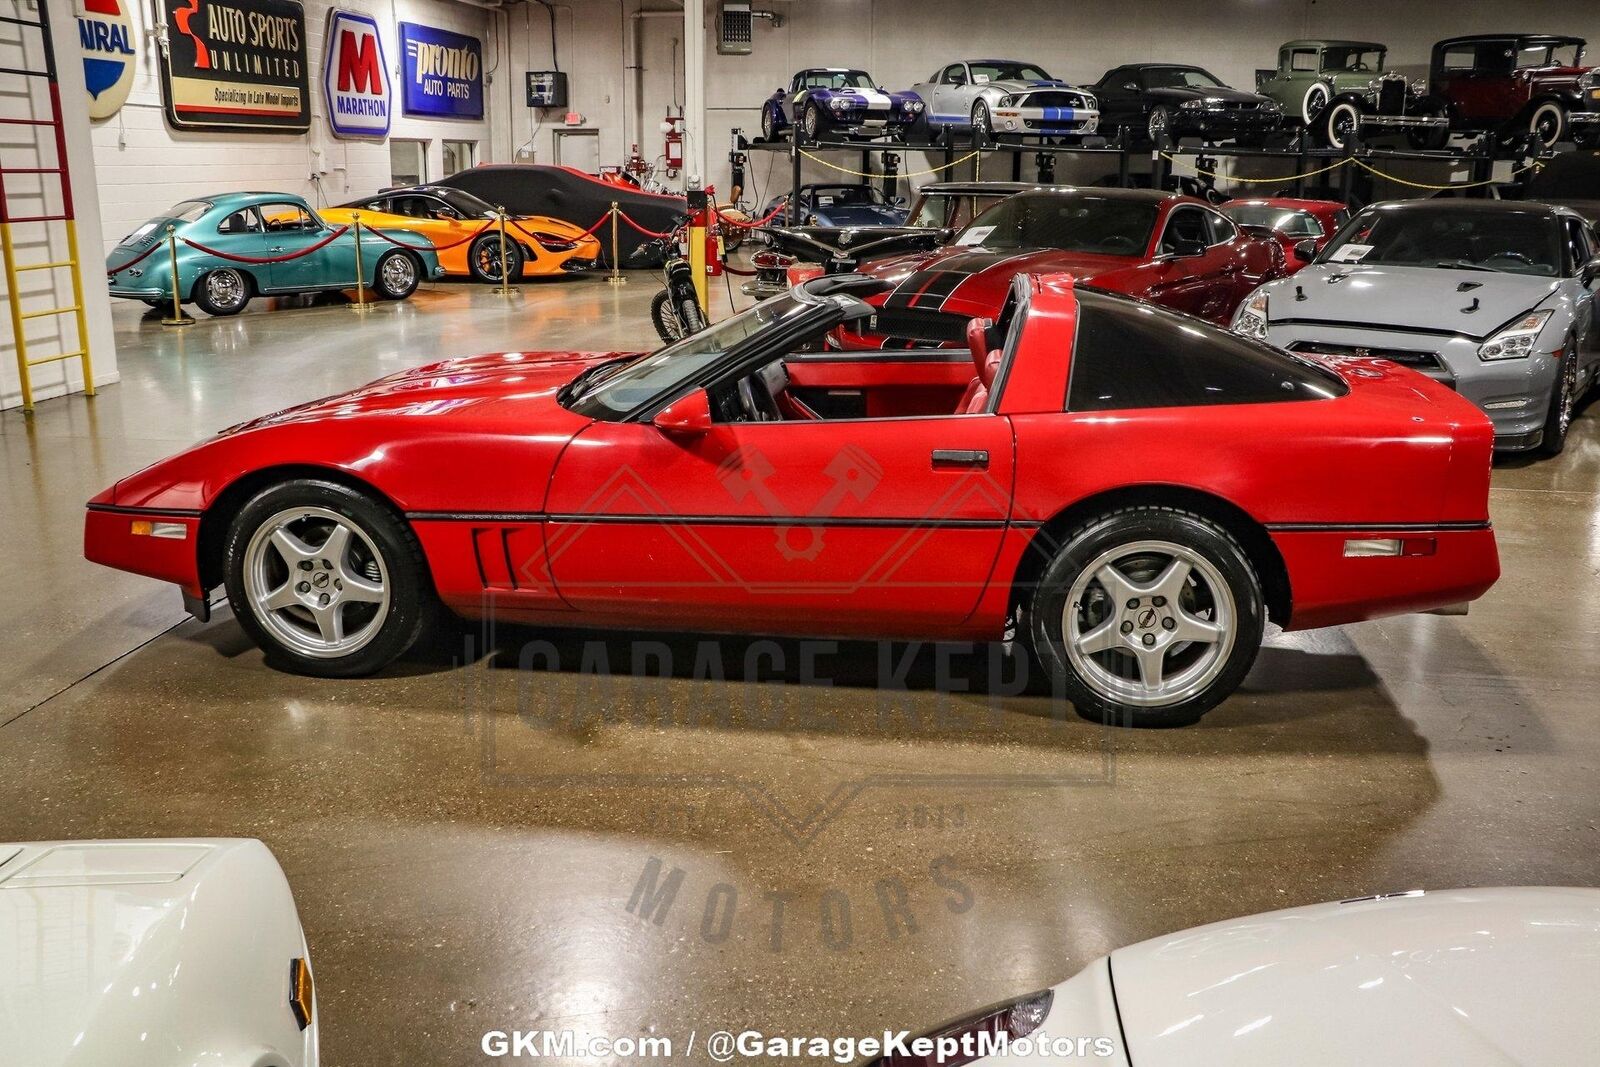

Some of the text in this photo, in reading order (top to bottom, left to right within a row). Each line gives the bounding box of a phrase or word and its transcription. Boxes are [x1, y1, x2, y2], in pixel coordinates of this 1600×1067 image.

[207, 3, 299, 52] AUTO SPORTS
[210, 49, 300, 78] UNLIMITED
[337, 29, 383, 95] M
[416, 41, 478, 84] pronto
[214, 87, 247, 105] Specializing
[253, 92, 265, 105] Late
[265, 92, 280, 106] Model
[423, 78, 470, 99] AUTO PARTS
[337, 96, 386, 117] MARATHON
